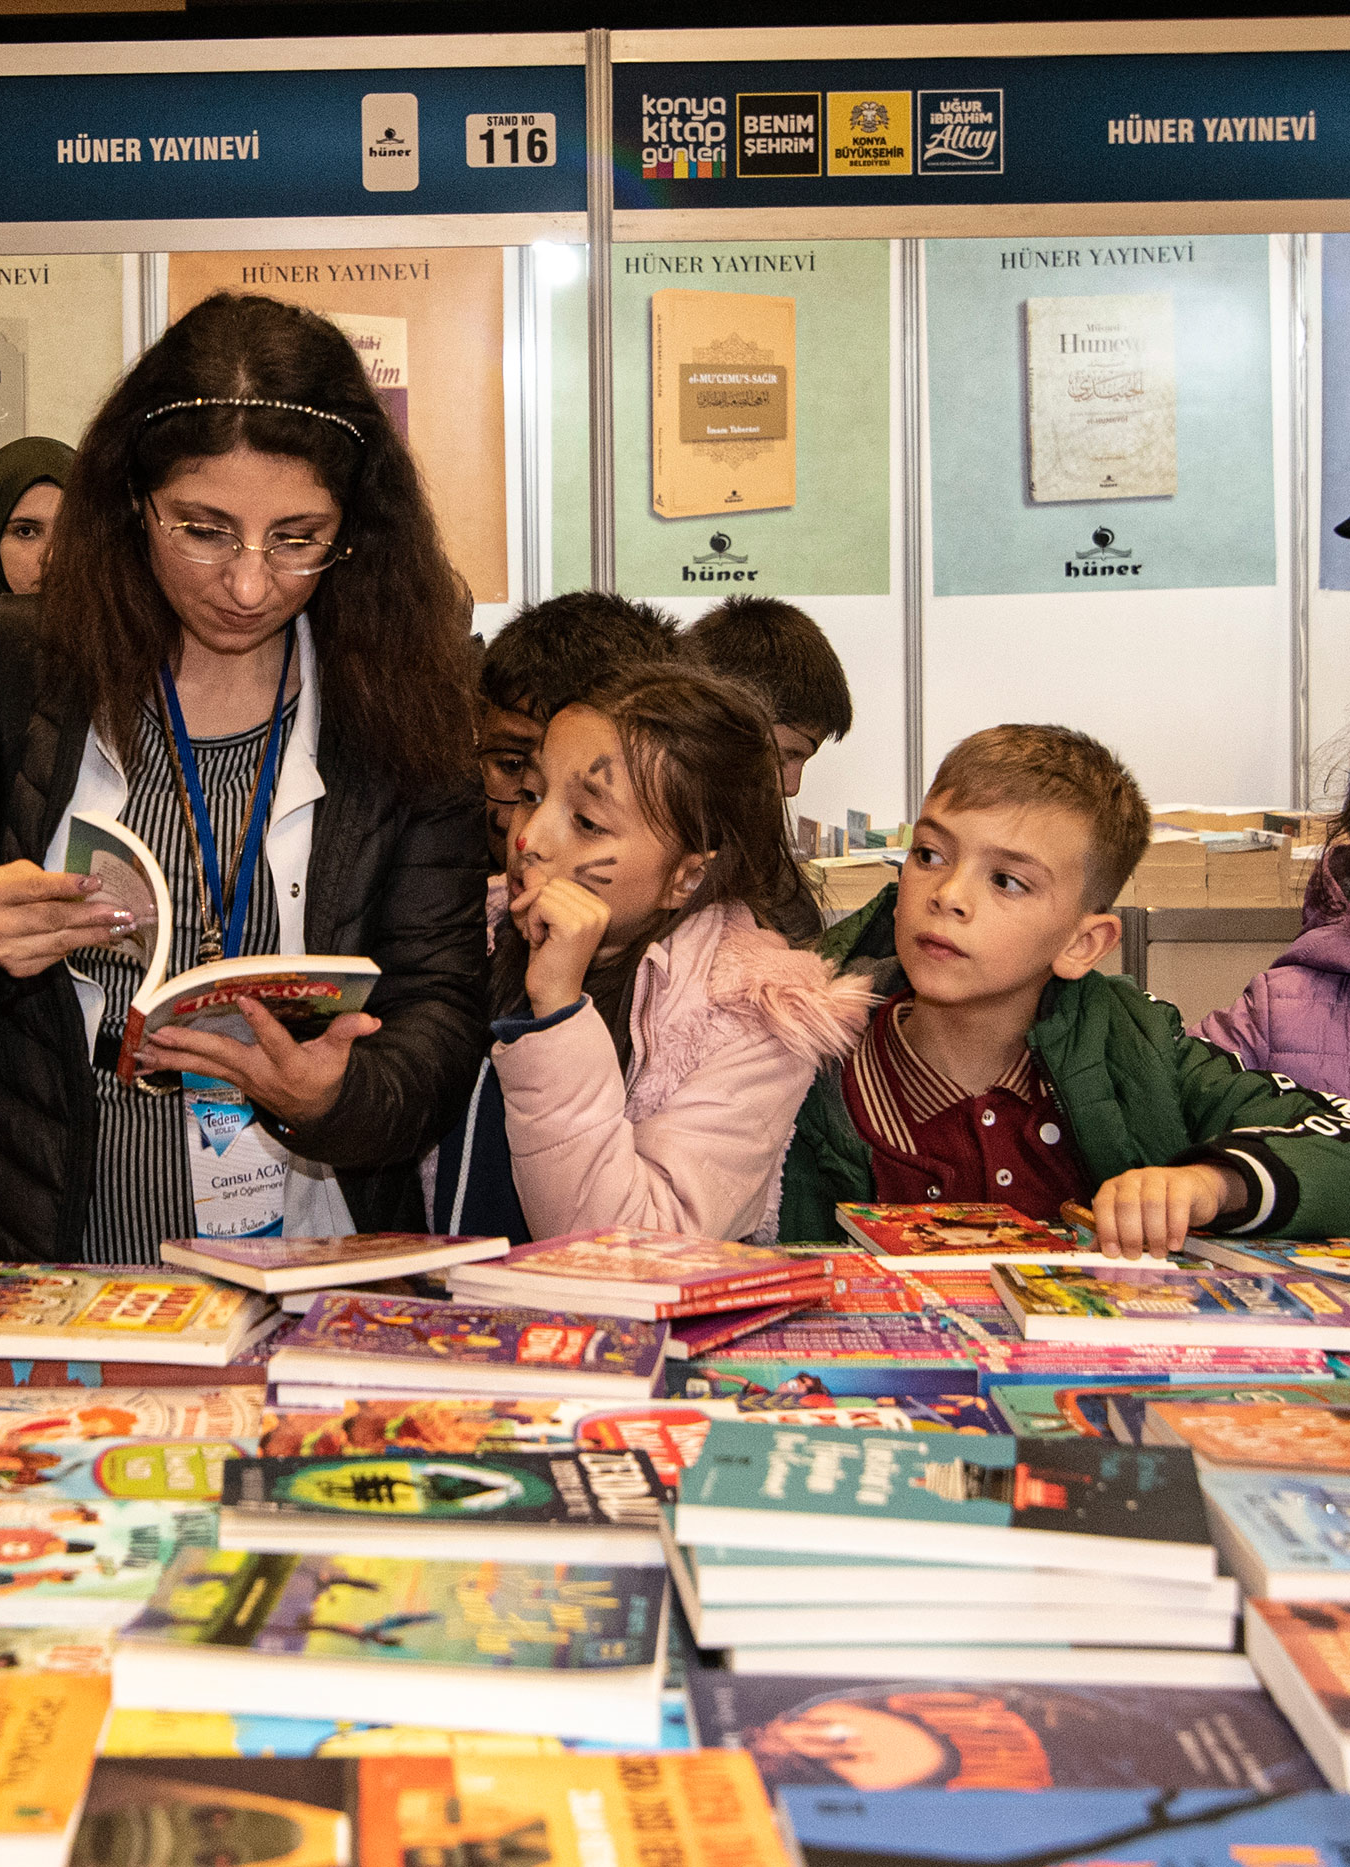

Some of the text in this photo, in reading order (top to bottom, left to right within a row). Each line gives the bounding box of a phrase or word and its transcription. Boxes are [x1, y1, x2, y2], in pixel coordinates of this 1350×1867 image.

[642, 94, 726, 121] konya
[940, 98, 982, 113] UĞUR
[487, 115, 535, 127] STAND NO
[642, 116, 726, 146] kitap
[1108, 111, 1316, 144] HÜNER YAYINEVİ
[58, 130, 259, 163] HÜNER YAYINEVİ
[370, 146, 411, 158] hüner
[479, 127, 548, 164] 116
[835, 146, 904, 160] BÜYÜKŞEHİR
[852, 137, 886, 146] KONYA
[923, 125, 997, 161] Altay
[642, 143, 726, 168] günleri
[625, 249, 817, 275] HÜNER YAYINEVİ
[1001, 242, 1194, 270] HÜNER YAYINEVİ
[242, 258, 430, 284] HÜNER YAYINEVİ
[682, 566, 758, 583] hüner
[1065, 561, 1142, 578] hüner
[211, 1172, 252, 1189] Cansu
